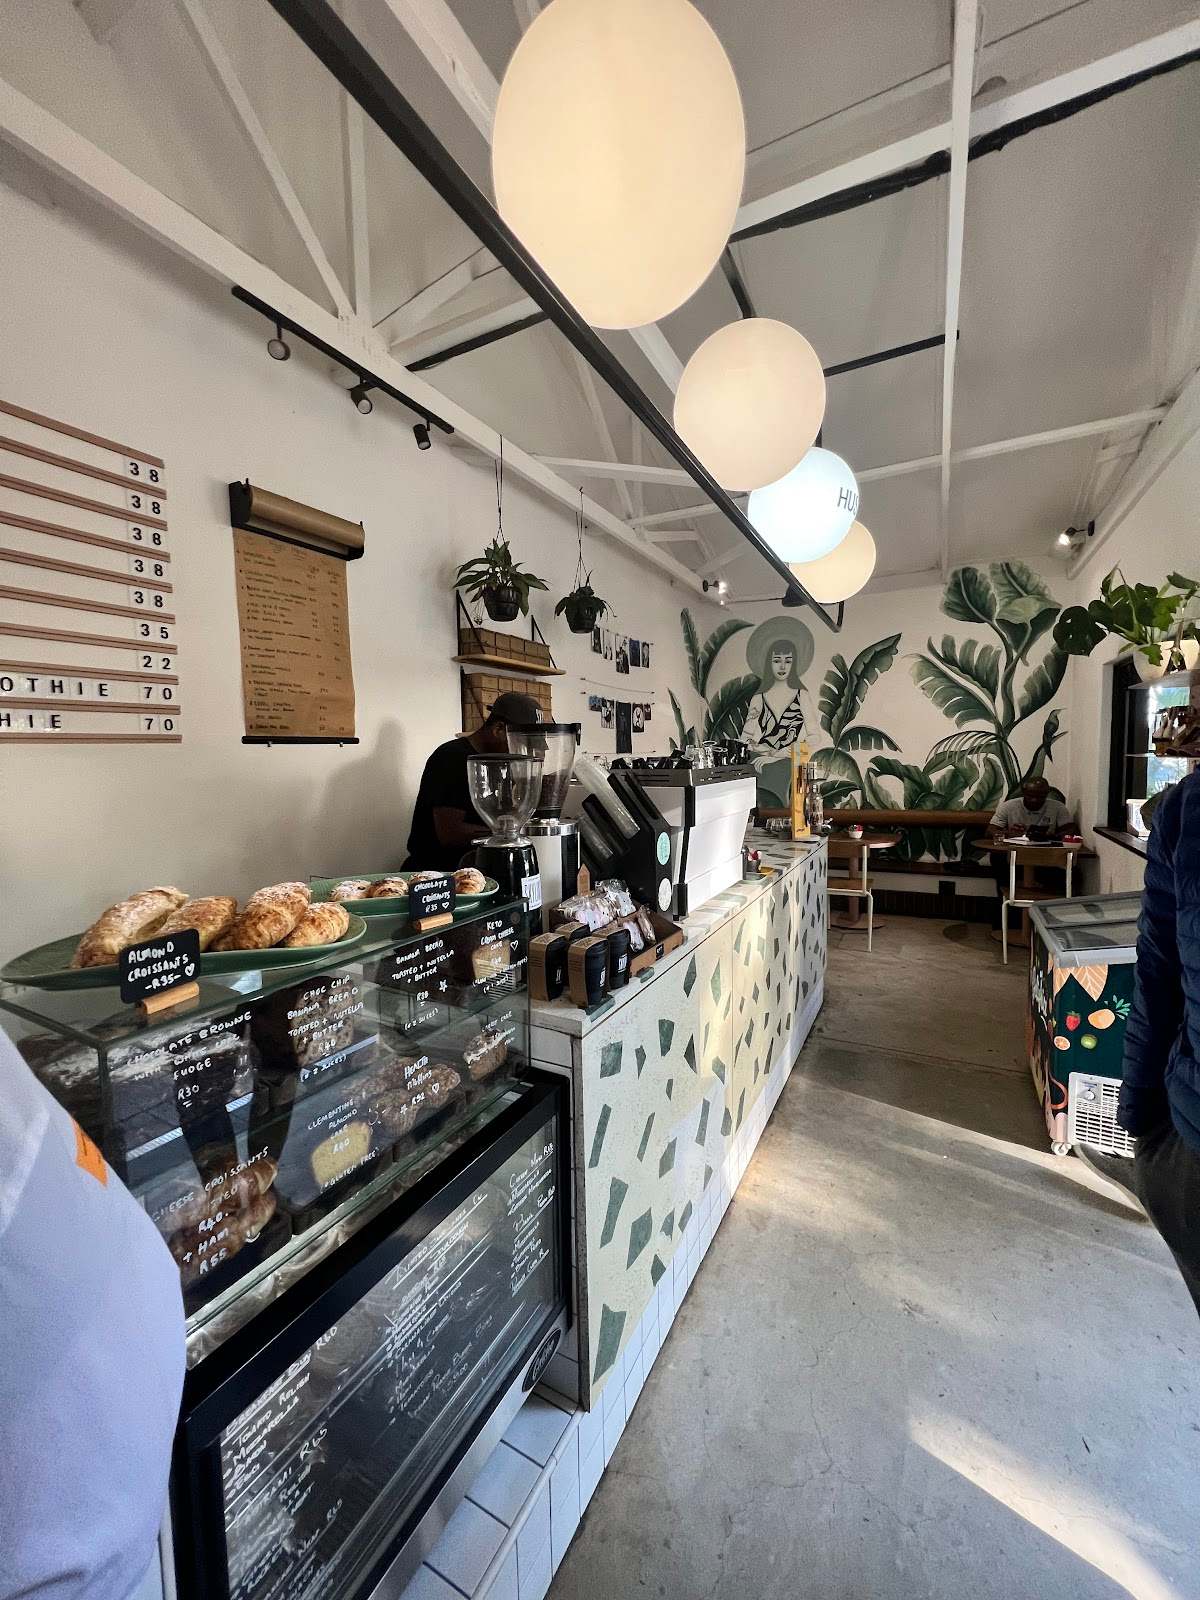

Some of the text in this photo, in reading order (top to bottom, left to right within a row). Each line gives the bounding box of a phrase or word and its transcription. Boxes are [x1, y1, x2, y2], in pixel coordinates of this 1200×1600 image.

[129, 462, 160, 482] 38
[131, 496, 161, 515] 38
[132, 527, 162, 546] 38
[134, 559, 164, 577] 38
[134, 591, 163, 607] 38
[140, 623, 169, 639] 35
[142, 656, 171, 670] 22
[144, 686, 172, 700] 70
[145, 718, 173, 731] 70
[426, 904, 438, 912] R35
[486, 920, 503, 931] KETO
[128, 941, 174, 963] ALMOND
[396, 949, 420, 964] BANANA
[127, 954, 189, 982] CROISSANTS
[391, 966, 418, 980] TOASTED
[426, 949, 455, 967] NUTELLA
[414, 966, 438, 982] BUTTER
[303, 974, 350, 1000] CHOC CHIP
[287, 987, 359, 1019] BANANA BREAD
[287, 1020, 319, 1037] TOASTED
[333, 1001, 364, 1019] NUTELLA
[312, 1020, 344, 1040] BUTTER
[173, 1057, 212, 1080] FUDGE
[177, 1085, 200, 1100] R30
[308, 1098, 354, 1130] CLEMENTINE
[328, 1108, 358, 1129] ALMOND
[205, 1146, 269, 1191] CROISSANTS
[232, 1410, 272, 1447] TOMATO
